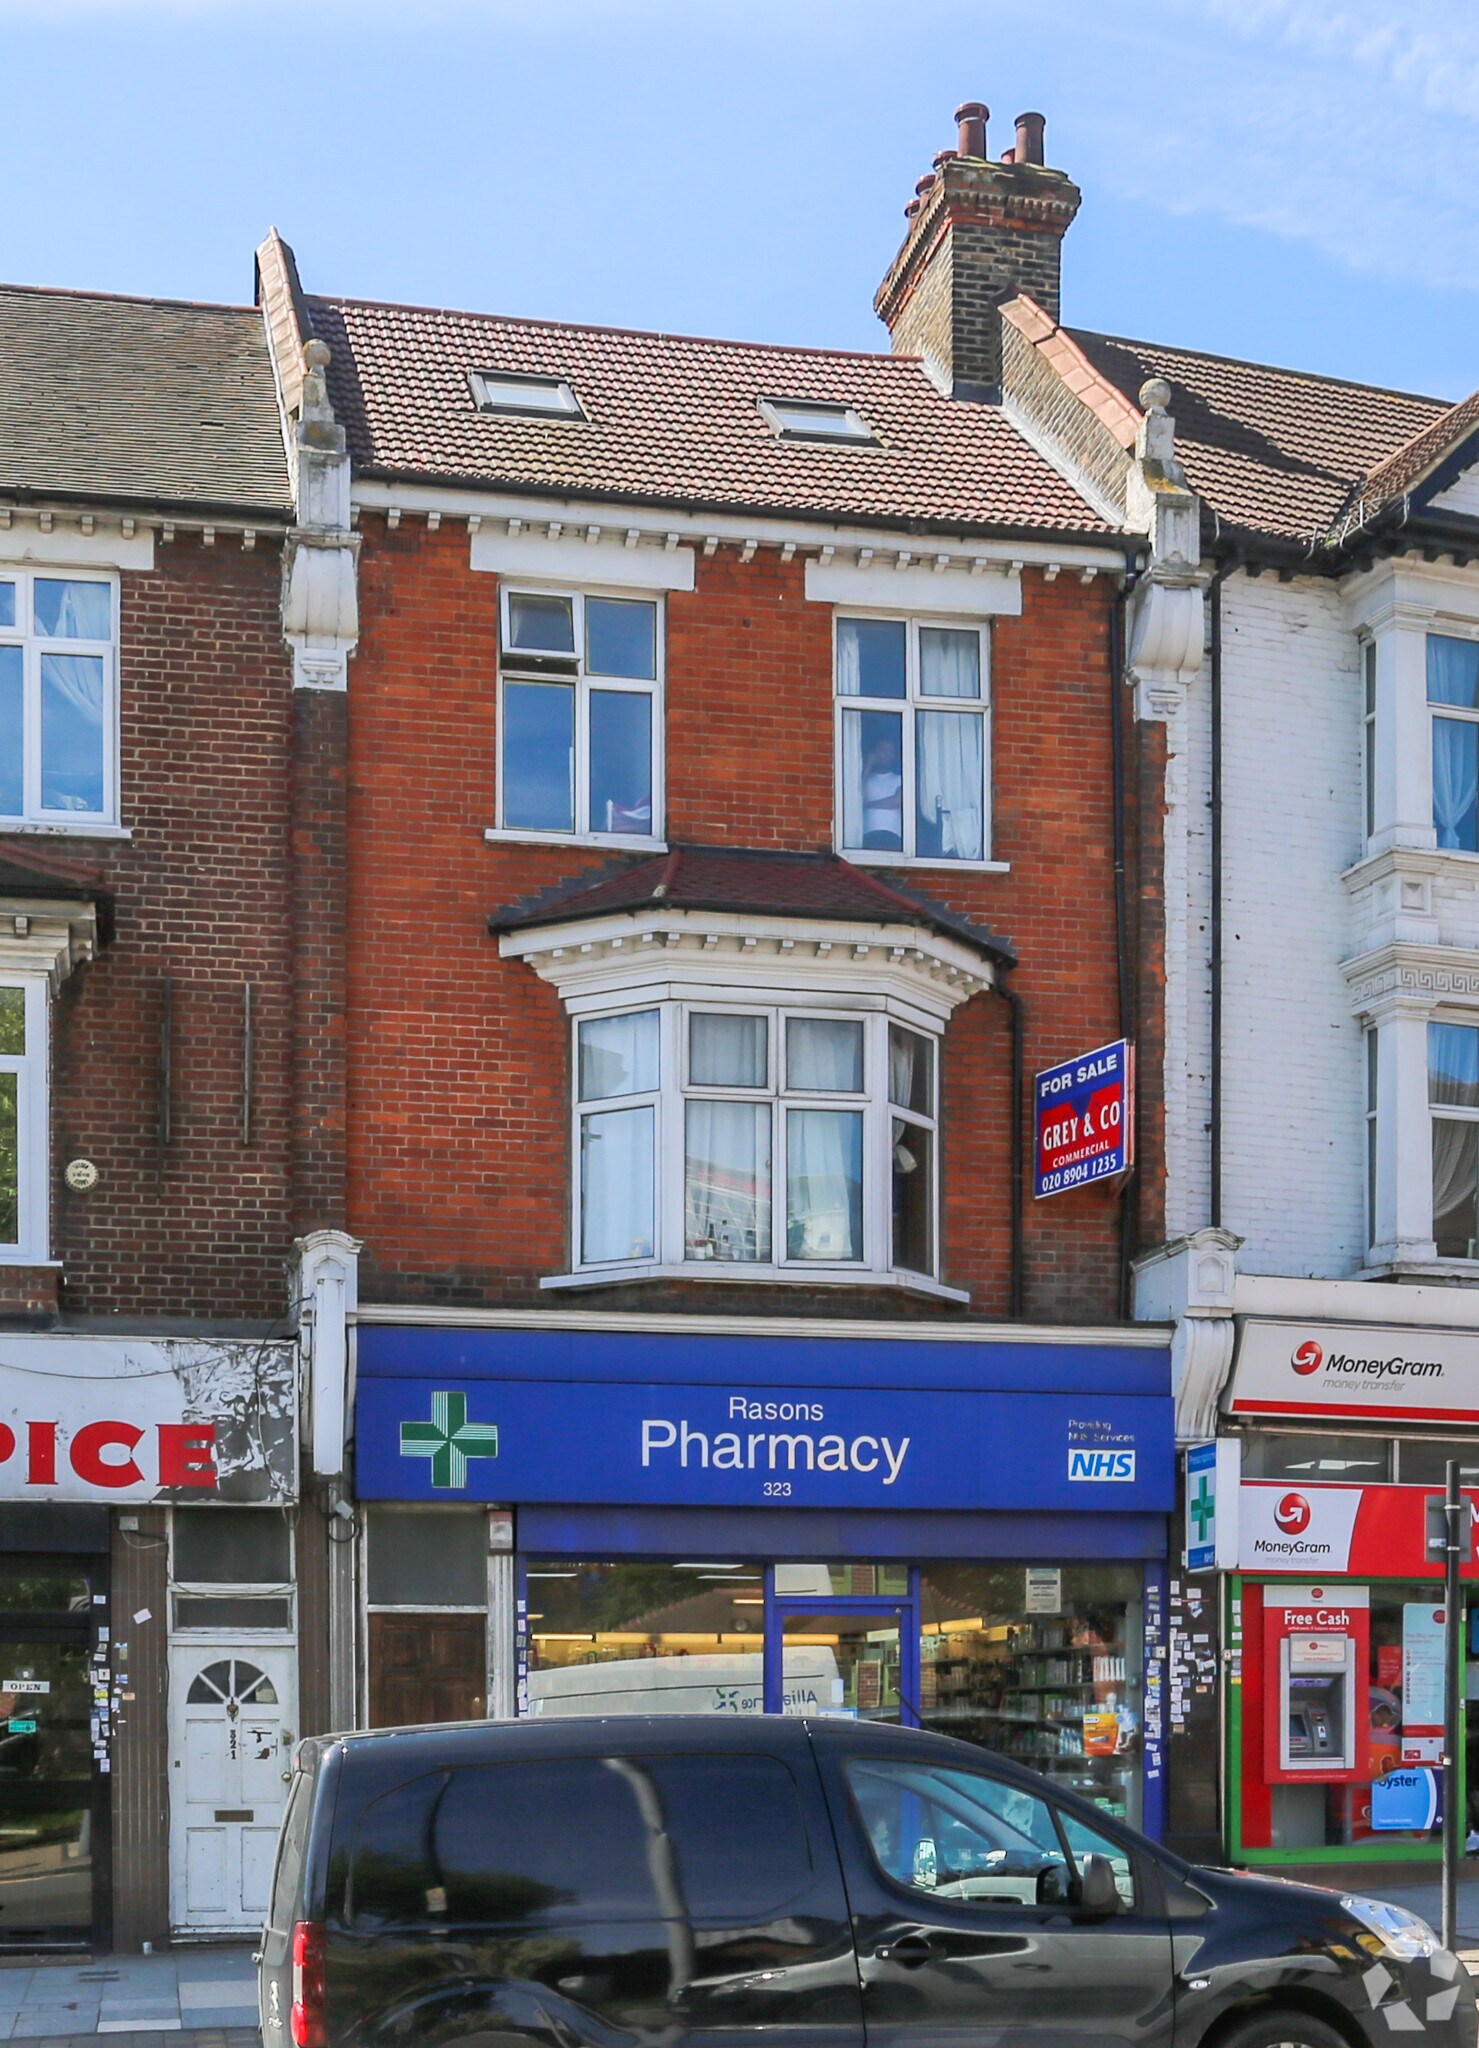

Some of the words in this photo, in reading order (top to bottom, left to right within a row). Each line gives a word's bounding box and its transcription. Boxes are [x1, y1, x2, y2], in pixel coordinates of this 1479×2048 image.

[1041, 1073, 1072, 1097] FOR
[1077, 1054, 1117, 1083] SALE
[1043, 1117, 1078, 1150] GREY
[1083, 1112, 1094, 1136] &
[1100, 1101, 1120, 1130] CO
[1052, 1140, 1110, 1168] COMMERCIAL
[1042, 1172, 1061, 1192] 020
[1063, 1163, 1088, 1185] 8904
[1092, 1153, 1116, 1176] 1235
[1325, 1354, 1443, 1379] MoneyGram
[1322, 1380, 1361, 1392] money
[1362, 1379, 1405, 1392] transfer
[729, 1396, 824, 1421] Rasons
[641, 1419, 910, 1485] Pharmacy
[1071, 1453, 1133, 1477] NHS
[763, 1482, 792, 1496] 323
[1254, 1540, 1331, 1556] MoneyGram
[1284, 1610, 1312, 1625] Free
[1316, 1610, 1349, 1625] Cash
